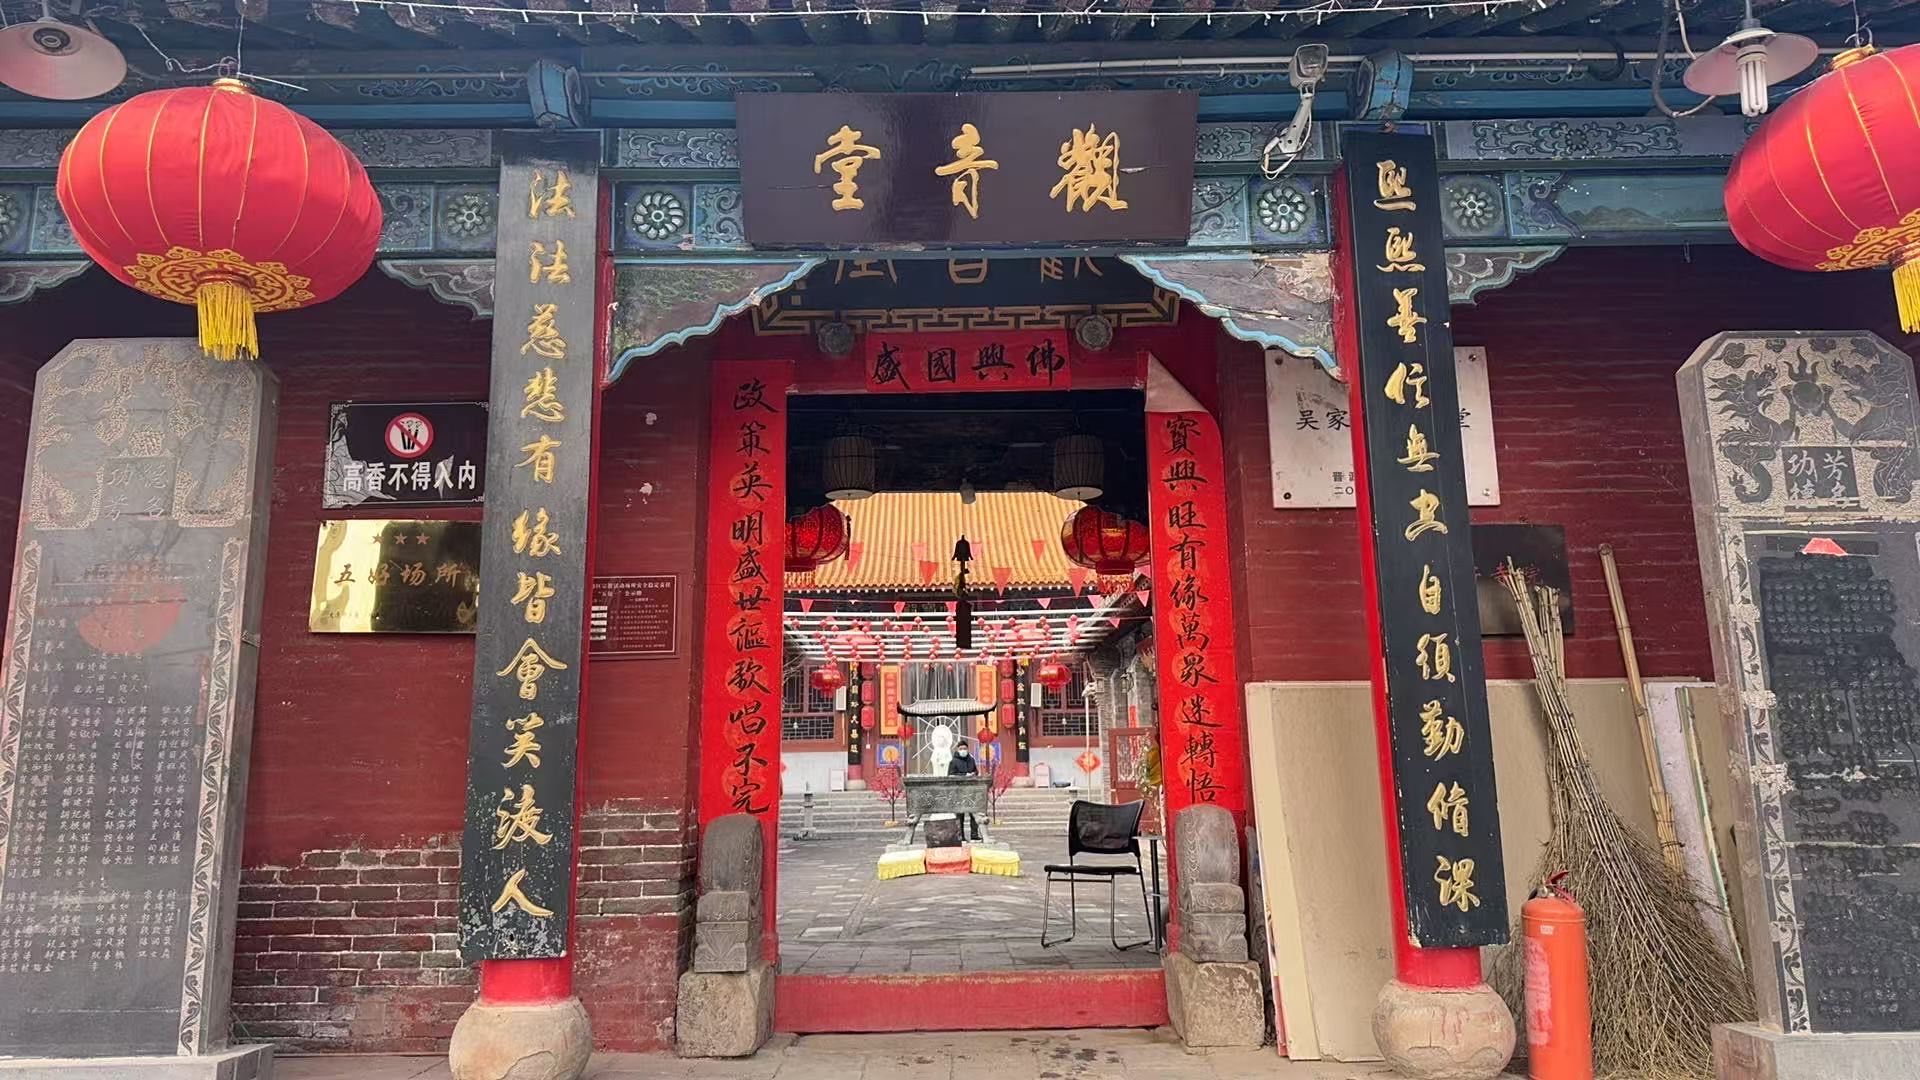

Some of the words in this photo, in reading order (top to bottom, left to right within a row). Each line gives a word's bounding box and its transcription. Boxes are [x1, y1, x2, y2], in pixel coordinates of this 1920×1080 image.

[813, 122, 1129, 219] 觀音堂
[333, 563, 460, 587] 五好场所
